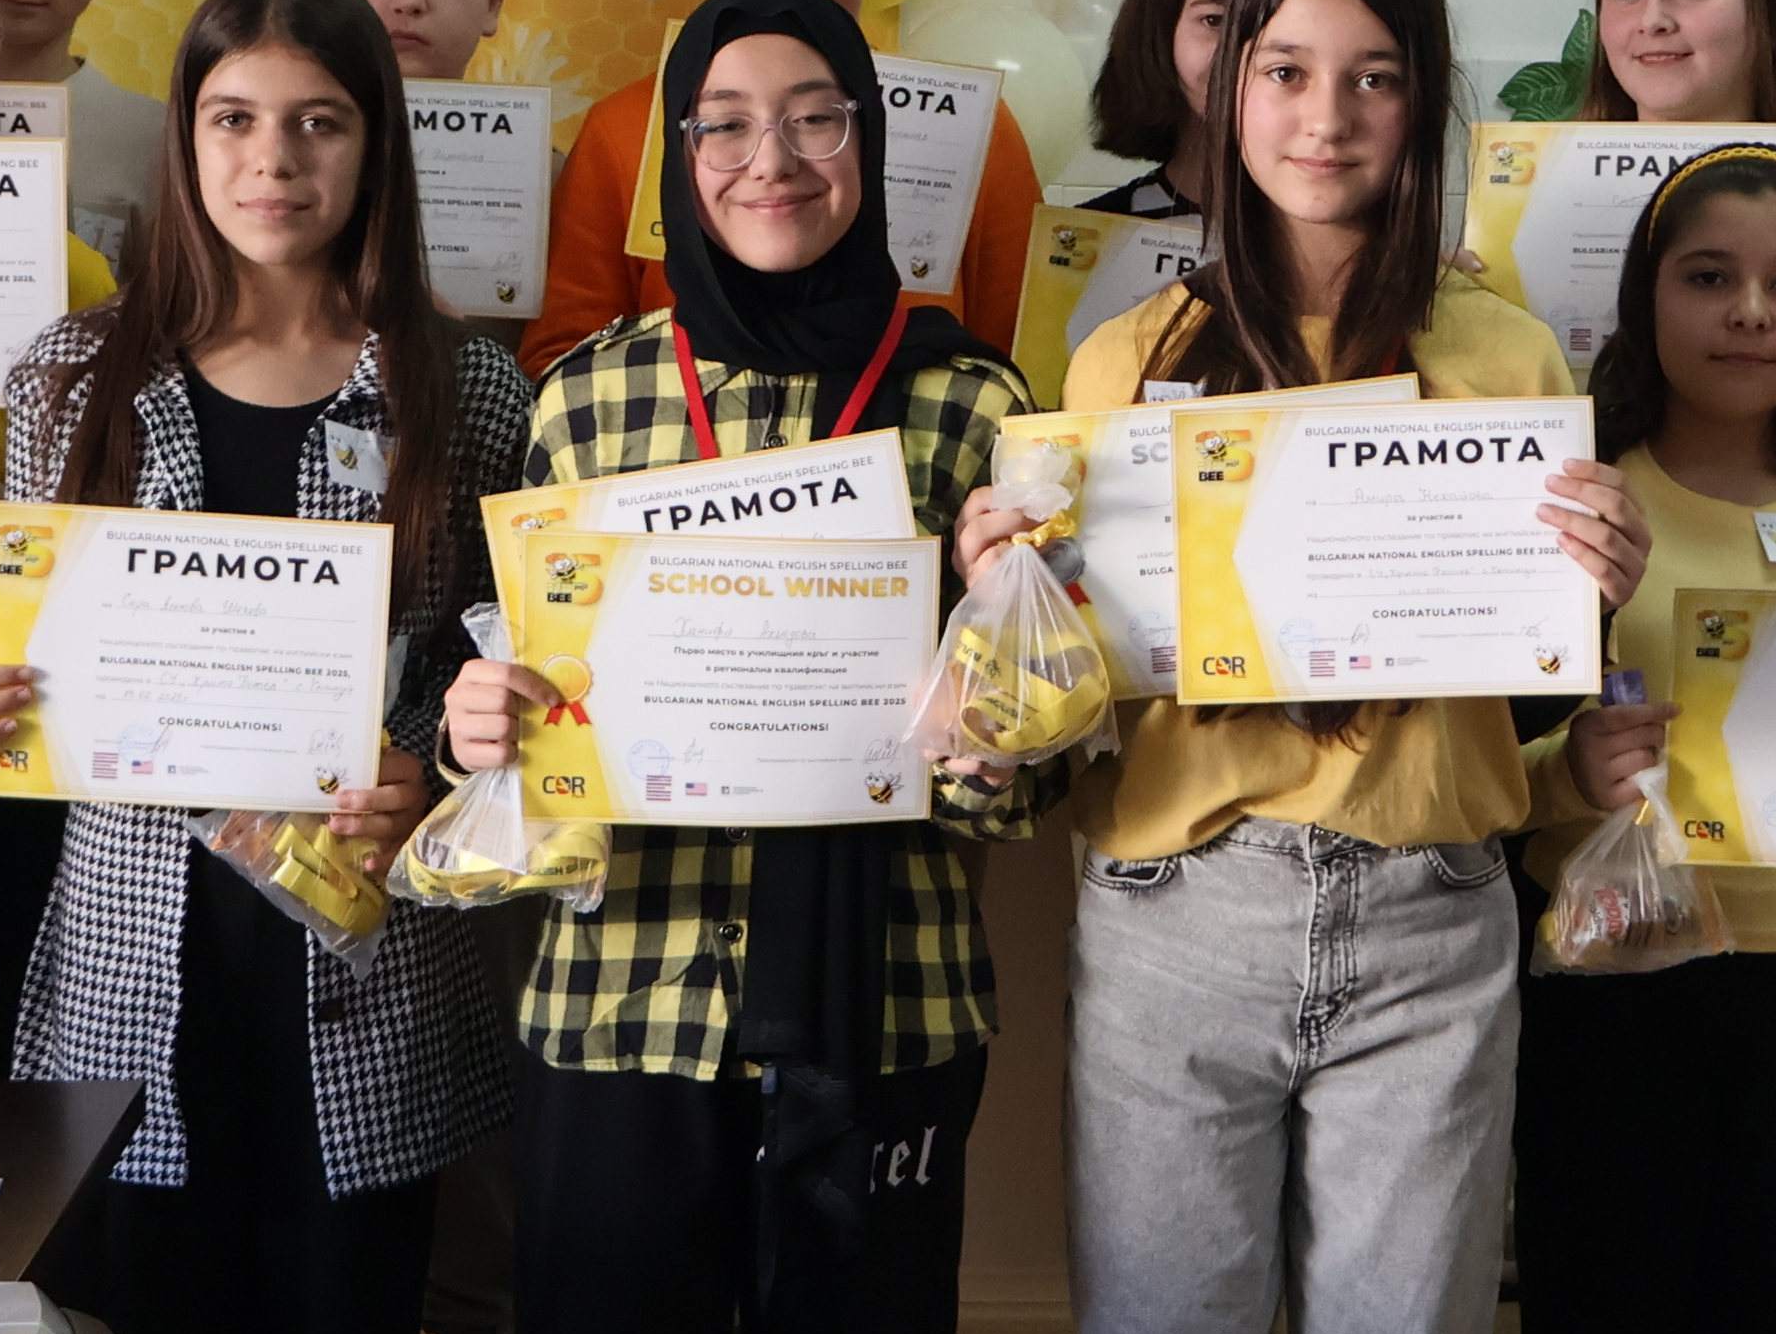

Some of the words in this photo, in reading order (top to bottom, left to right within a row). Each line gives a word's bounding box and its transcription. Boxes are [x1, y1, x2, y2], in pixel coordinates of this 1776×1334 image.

[412, 109, 514, 135] МОТА
[19, 158, 39, 169] BEE
[1593, 153, 1688, 178] ГРАМ
[1129, 425, 1171, 438] BULGA
[1305, 425, 1370, 437] BULGARIAN
[1374, 423, 1431, 435] NATIONAL
[1434, 421, 1482, 433] ENGLISH
[1486, 420, 1540, 431] SPELLING
[1543, 419, 1565, 430] BEE
[1328, 436, 1545, 468] ГРАМОТА
[617, 487, 682, 508] BULGARIAN
[686, 477, 742, 497] NATIONAL
[745, 469, 793, 487] ENGLISH
[796, 459, 850, 479] SPELLING
[853, 455, 874, 469] BEE
[1198, 471, 1224, 482] BEE
[642, 476, 859, 533] ГРАМОТА
[106, 531, 171, 544] BULGARIAN
[174, 534, 231, 548] NATIONAL
[234, 538, 281, 551] ENGLISH
[285, 541, 339, 554] SPELLING
[342, 544, 363, 555] BEE
[1308, 552, 1365, 562] BULGARIAN
[1368, 550, 1417, 561] NATIONAL
[1421, 549, 1463, 559] ENGLISH
[1466, 548, 1513, 558] SPELLING
[1516, 547, 1535, 557] BEE
[1539, 546, 1563, 556] 2025,
[127, 547, 340, 585] ГРАМОТА
[650, 556, 715, 567] BULGARIAN
[718, 557, 775, 568] NATIONAL
[778, 558, 826, 569] ENGLISH
[830, 559, 884, 570] SPELLING
[887, 560, 908, 571] BEE
[648, 573, 774, 597] SCHOOL
[784, 576, 909, 598] WINNER
[1372, 607, 1498, 619] CONGRATULATIONS!
[674, 646, 705, 657] Първо
[747, 649, 804, 659] училищния
[840, 649, 880, 659] участие
[99, 655, 156, 668] BULGARIAN
[159, 658, 207, 670] NATIONAL
[210, 661, 252, 673] ENGLISH
[255, 664, 301, 676] SPELLING
[304, 666, 323, 677] BEE
[326, 668, 351, 678] 2025,
[714, 665, 772, 675] регионална
[774, 665, 848, 675] квалификация
[644, 695, 703, 705] BULGARIAN
[706, 696, 758, 706] NATIONAL
[762, 696, 806, 706] ENGLISH
[809, 696, 857, 707] SPELLING
[861, 697, 880, 707] BEE
[883, 697, 906, 707] 2025
[158, 715, 282, 733] CONGRATULATIONS!
[709, 721, 829, 732] CONGRATULATIONS!
[868, 1125, 938, 1193] rel
